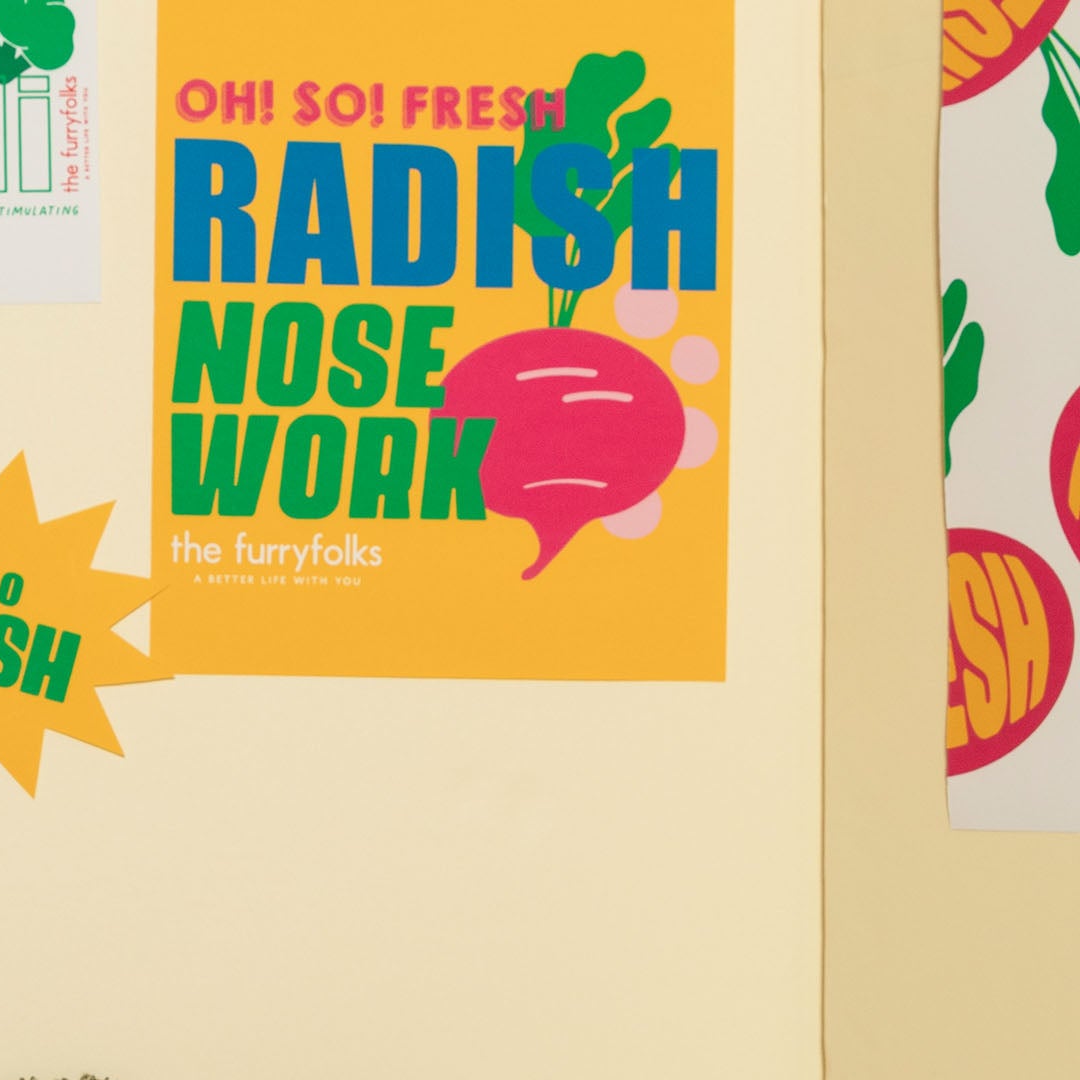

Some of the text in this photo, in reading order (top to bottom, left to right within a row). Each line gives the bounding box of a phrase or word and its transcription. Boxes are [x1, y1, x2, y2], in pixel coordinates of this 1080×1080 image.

[59, 76, 82, 193] the furryfolks
[175, 78, 567, 131] OH! SO! FRESH
[172, 138, 718, 291] RADISH
[171, 300, 455, 409] NOSE
[171, 412, 497, 520] WORK
[170, 530, 384, 573] the furryfolks
[193, 574, 362, 586] A BETTER LIFE WITH YOU
